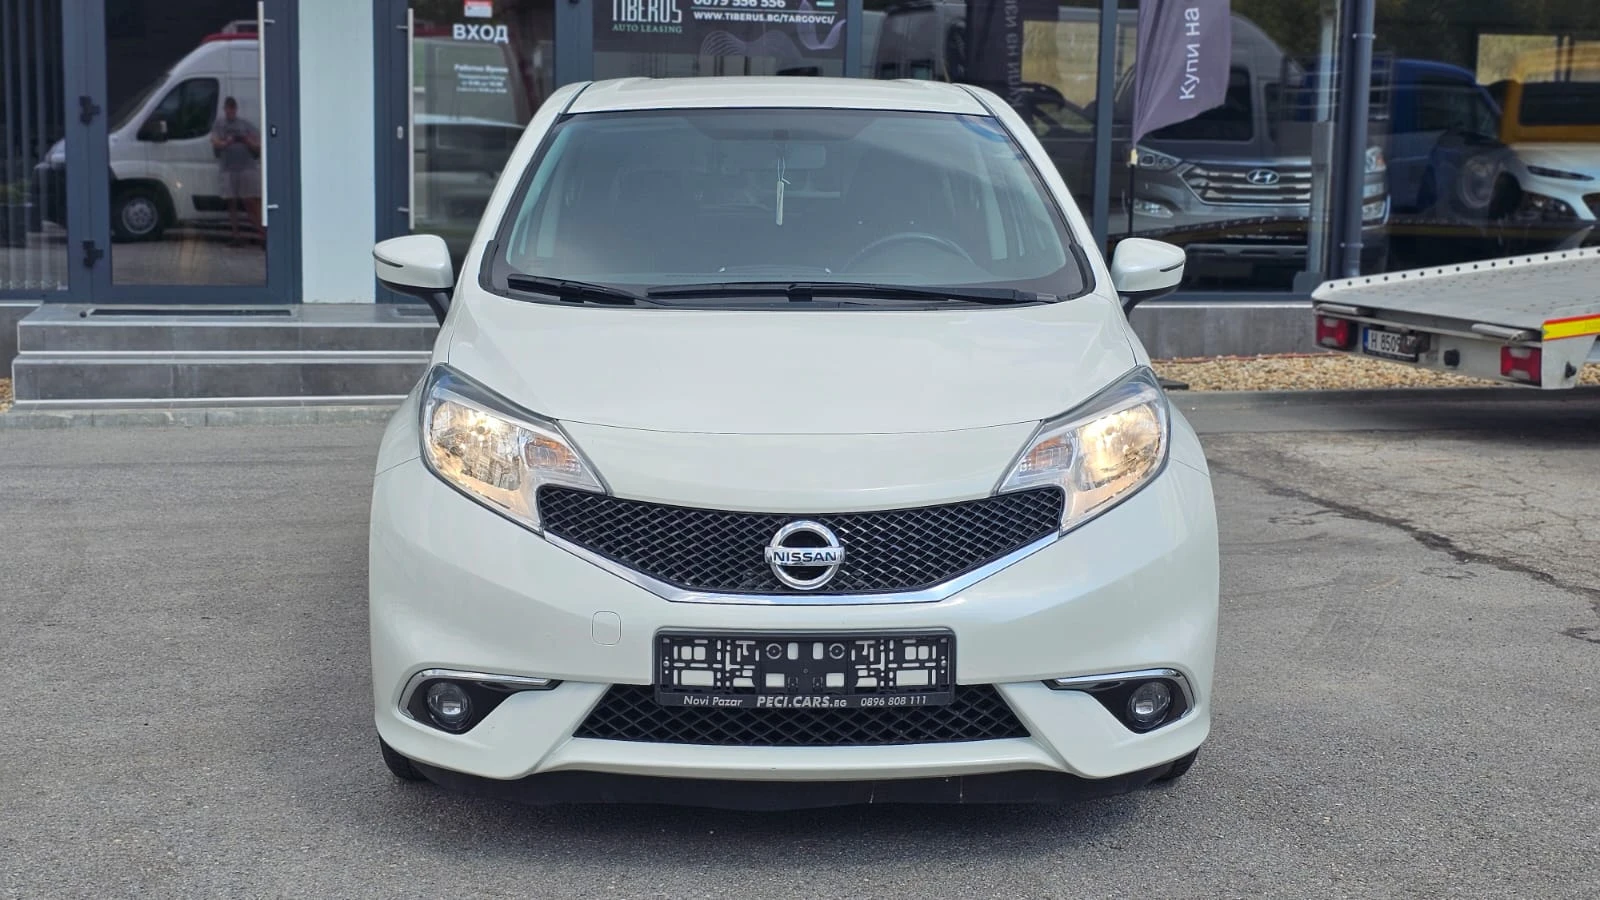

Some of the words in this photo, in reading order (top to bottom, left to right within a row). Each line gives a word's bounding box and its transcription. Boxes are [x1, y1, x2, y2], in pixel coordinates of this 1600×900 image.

[693, 11, 835, 25] WWW.TIBERUS.BG/TARGOVCI/
[1184, 7, 1200, 36] на
[453, 23, 509, 44] ВХОД
[612, 24, 638, 32] AUTO
[640, 25, 682, 33] LEASING
[1179, 43, 1200, 99] Купи
[773, 551, 838, 562] NISSAN
[683, 696, 709, 705] Novi
[712, 697, 743, 706] Pazar
[860, 697, 885, 707] 0896
[888, 697, 907, 706] 808
[910, 695, 927, 705] 111
